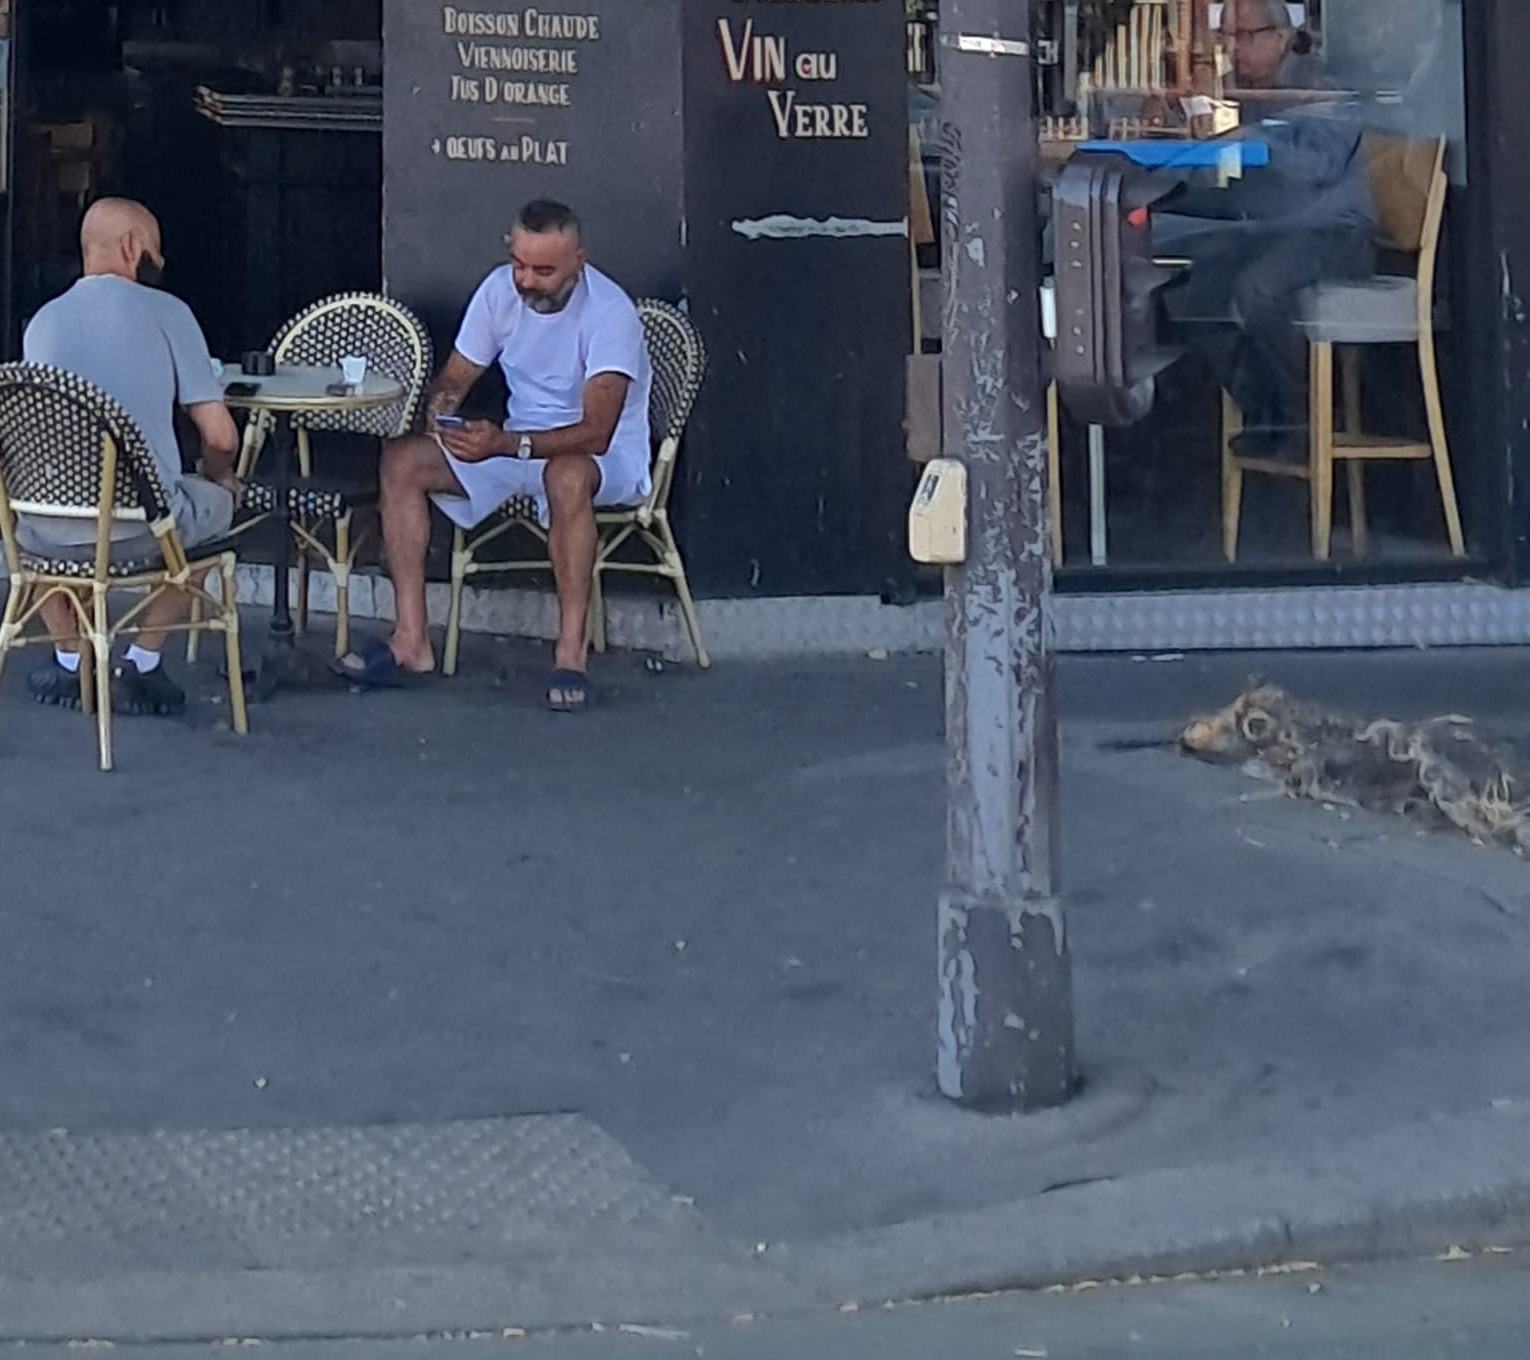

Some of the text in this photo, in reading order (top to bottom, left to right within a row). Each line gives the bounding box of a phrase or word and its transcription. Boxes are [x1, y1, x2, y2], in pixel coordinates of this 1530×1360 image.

[443, 7, 600, 39] BOISSON CHAUDE
[457, 41, 578, 74] VIENNOISERIE
[717, 17, 837, 81] VIN au
[450, 74, 480, 102] JUS
[768, 90, 868, 138] VERRE
[521, 136, 568, 165] PLAT
